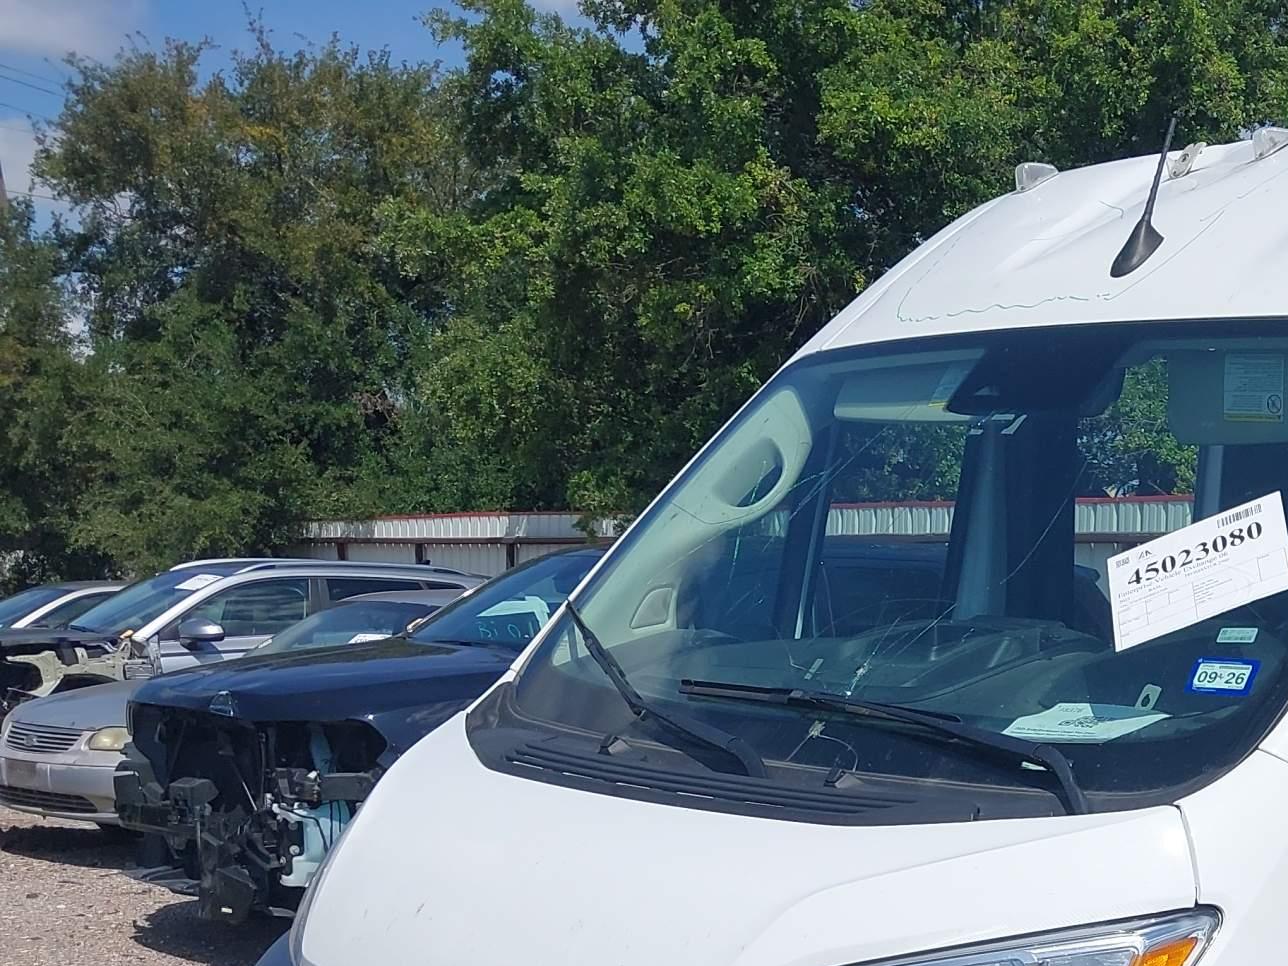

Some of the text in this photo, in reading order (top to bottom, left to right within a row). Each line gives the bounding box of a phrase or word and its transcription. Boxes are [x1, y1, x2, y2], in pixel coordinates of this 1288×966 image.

[1127, 522, 1263, 585] 45023080
[1197, 670, 1246, 685] 09 26
